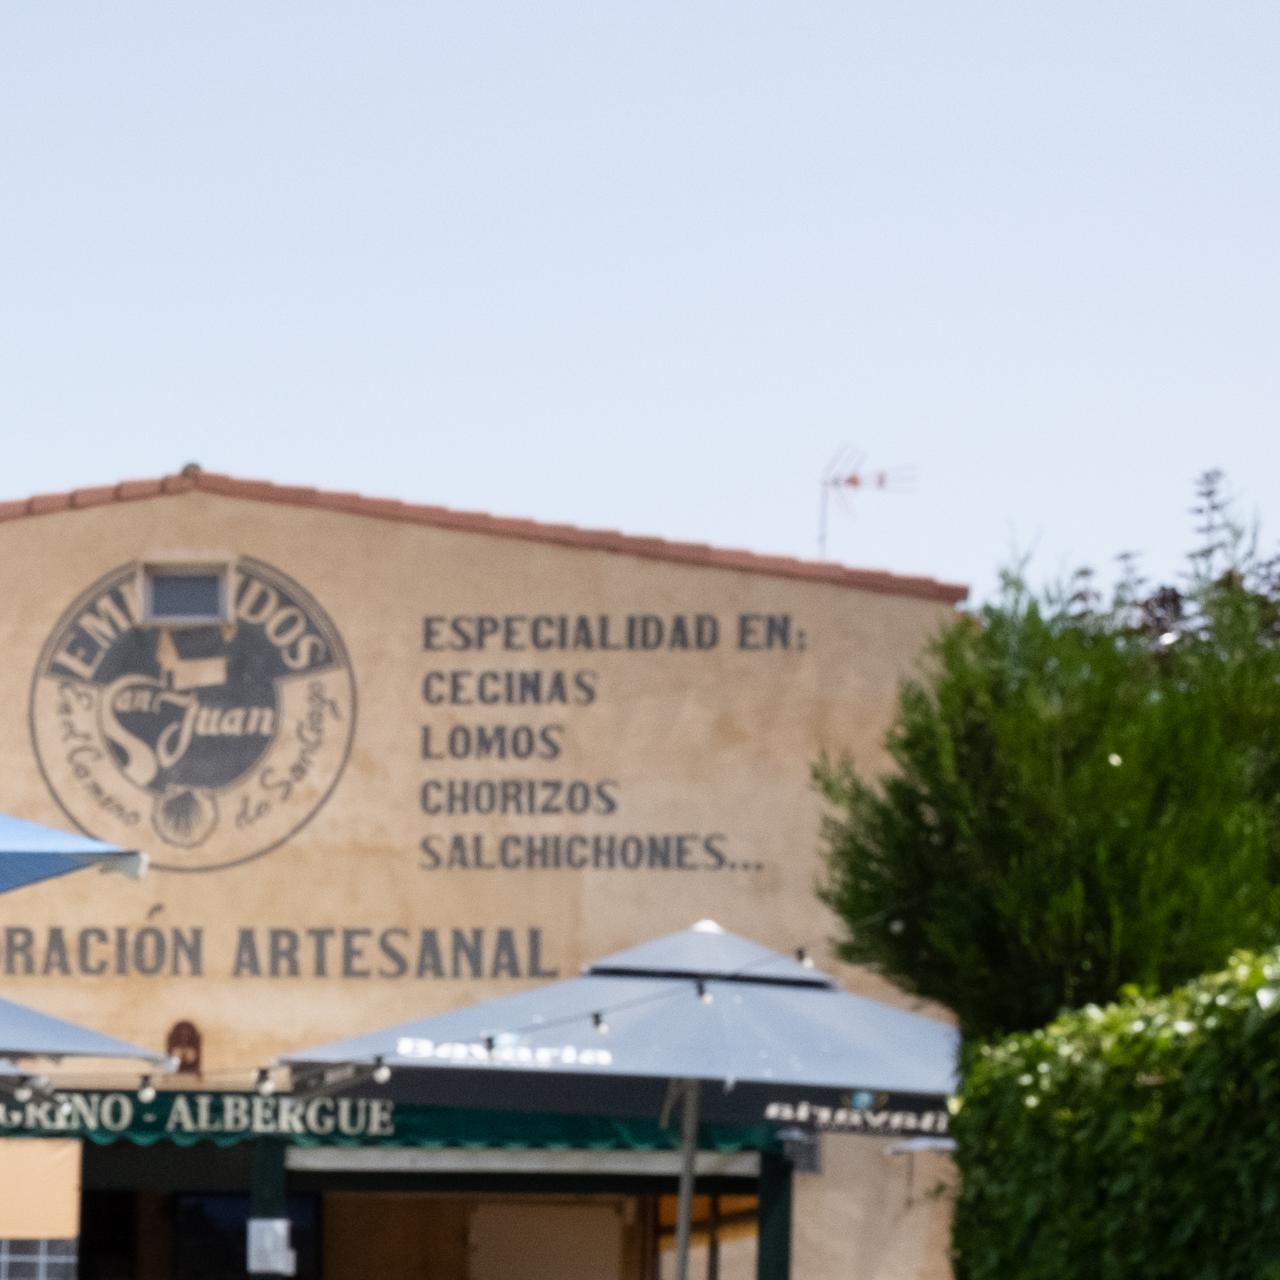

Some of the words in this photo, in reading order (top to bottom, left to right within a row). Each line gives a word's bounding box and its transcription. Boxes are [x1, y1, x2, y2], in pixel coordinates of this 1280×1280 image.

[52, 574, 327, 681] EMDOS
[420, 613, 721, 652] ESPECIALIDAD
[735, 612, 808, 652] EN:
[421, 670, 599, 705] CECINAS
[98, 672, 164, 788] San
[154, 691, 274, 770] Juan
[420, 725, 562, 760] LOMOS
[419, 780, 620, 816] CHORIZOS
[419, 834, 765, 871] SALCHICHONES...
[232, 927, 560, 979] ARTESANAL
[396, 1037, 613, 1066] Bavaria
[164, 1094, 395, 1137] ALBERGUE
